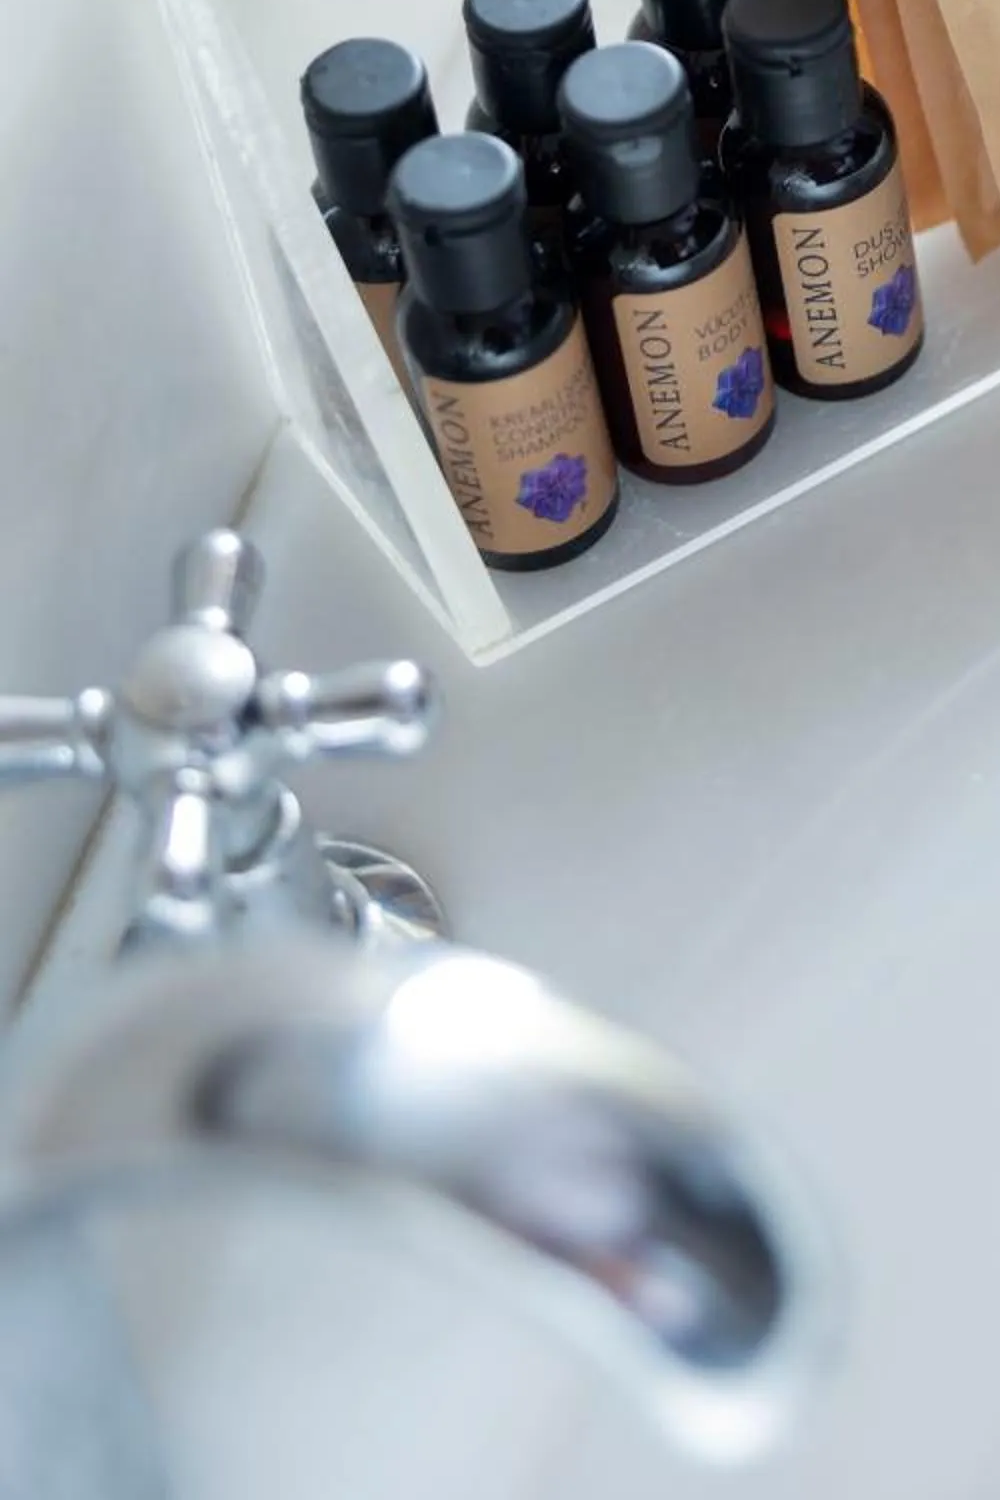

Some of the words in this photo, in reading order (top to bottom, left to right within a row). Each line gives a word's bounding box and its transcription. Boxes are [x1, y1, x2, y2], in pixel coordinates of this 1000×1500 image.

[792, 227, 846, 371] ANEMON
[634, 308, 690, 452] ANEMON
[431, 389, 495, 541] ANEMON
